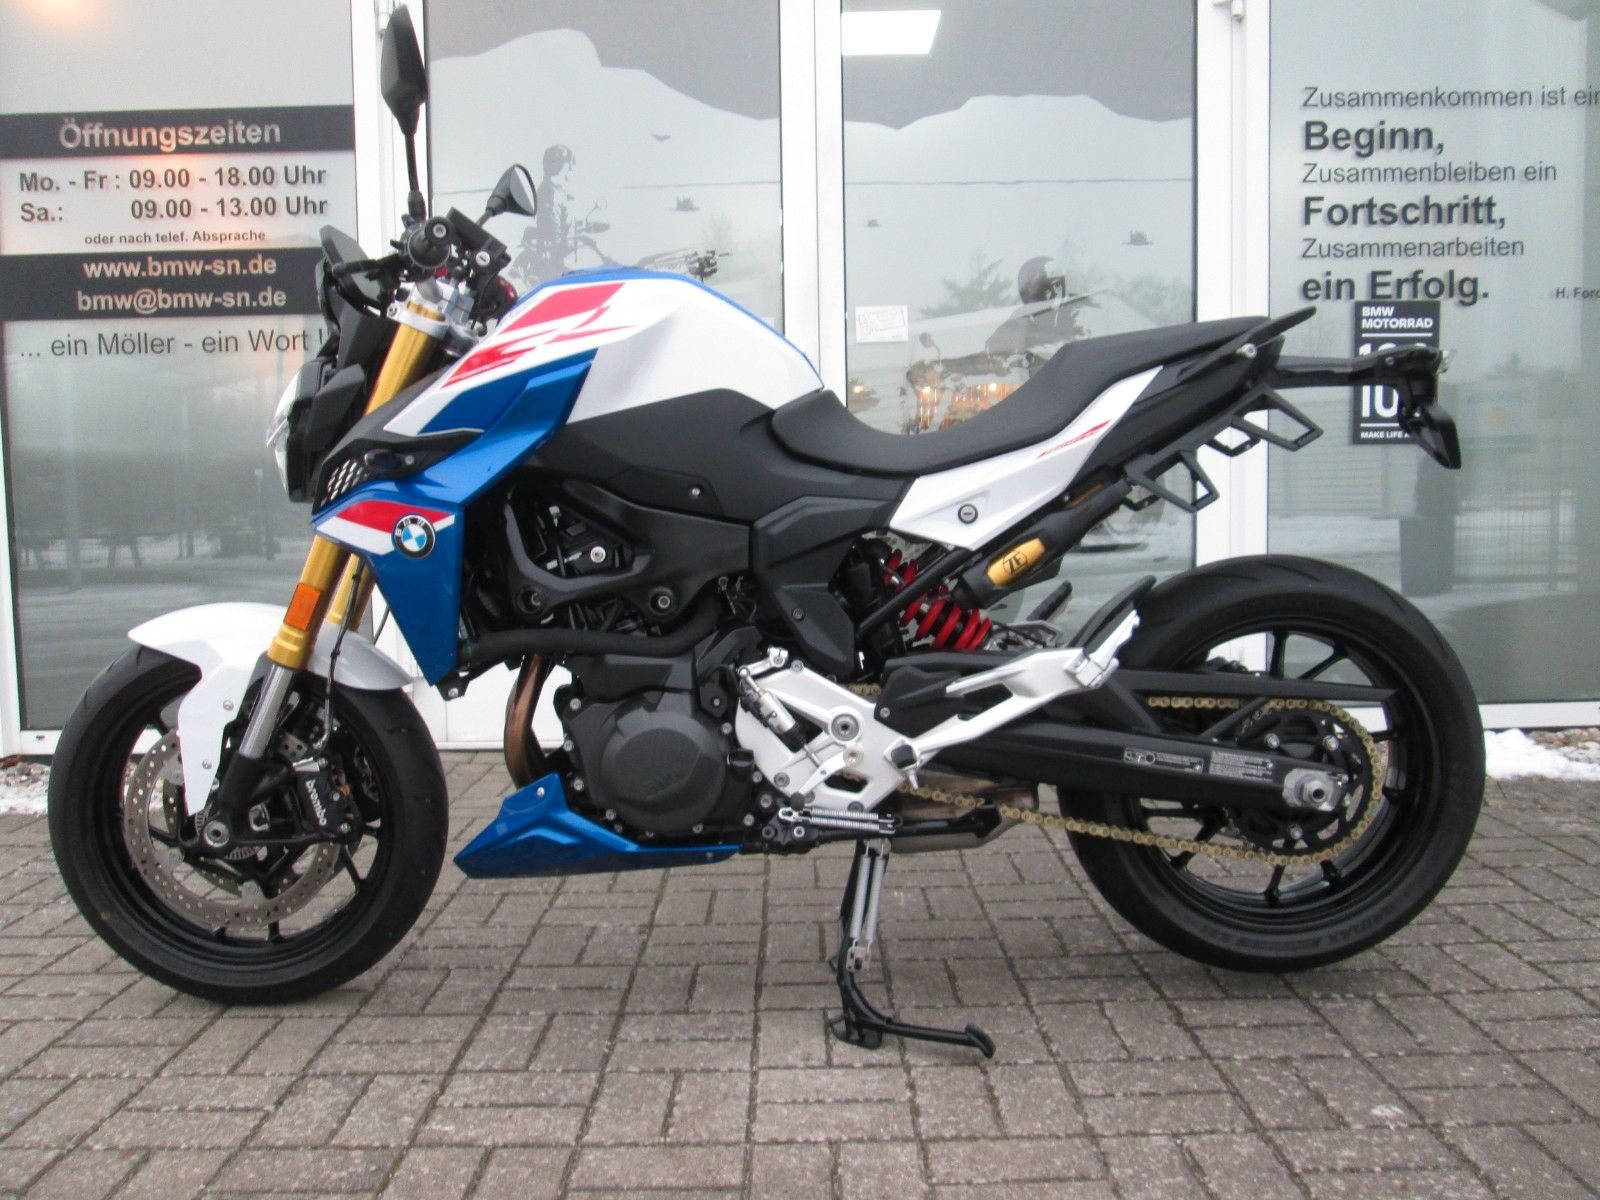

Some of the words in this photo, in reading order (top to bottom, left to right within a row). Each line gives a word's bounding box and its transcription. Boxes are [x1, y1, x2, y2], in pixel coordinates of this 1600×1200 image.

[1302, 85, 1533, 109] Zusammenkommen
[1540, 86, 1567, 107] ist
[59, 117, 282, 152] Öffnungszeiten
[1304, 120, 1444, 159] Beginn,
[19, 172, 61, 192] Mo.
[128, 168, 190, 190] 09.00
[214, 165, 276, 187] 18.00
[283, 165, 327, 186] Uhr
[1302, 162, 1516, 184] Zusammenbleiben
[1523, 160, 1557, 182] ein
[20, 202, 63, 223] Sa.:
[130, 198, 192, 220] 09.00
[216, 196, 277, 217] 13.00
[285, 195, 328, 217] Uhr
[1303, 194, 1506, 230] Fortschritt,
[84, 233, 115, 245] oder
[119, 232, 152, 244] nach
[155, 231, 189, 243] telef.
[192, 229, 266, 244] Absprache
[1301, 236, 1525, 259] Zusammenarbeiten
[83, 253, 277, 279] www.bmw-sn.de
[77, 285, 287, 315] bmw@bmw-sn.de
[1301, 270, 1356, 302] ein
[1370, 269, 1489, 307] Erfolg.
[1555, 287, 1570, 299] H.
[1361, 306, 1395, 317] BMW
[1361, 318, 1434, 329] MOTORRAD
[50, 333, 88, 357] ein
[97, 331, 176, 356] Möller
[201, 330, 239, 354] ein
[247, 328, 312, 352] Wort
[1360, 431, 1385, 439] MAKE
[1385, 430, 1403, 439] LIFE
